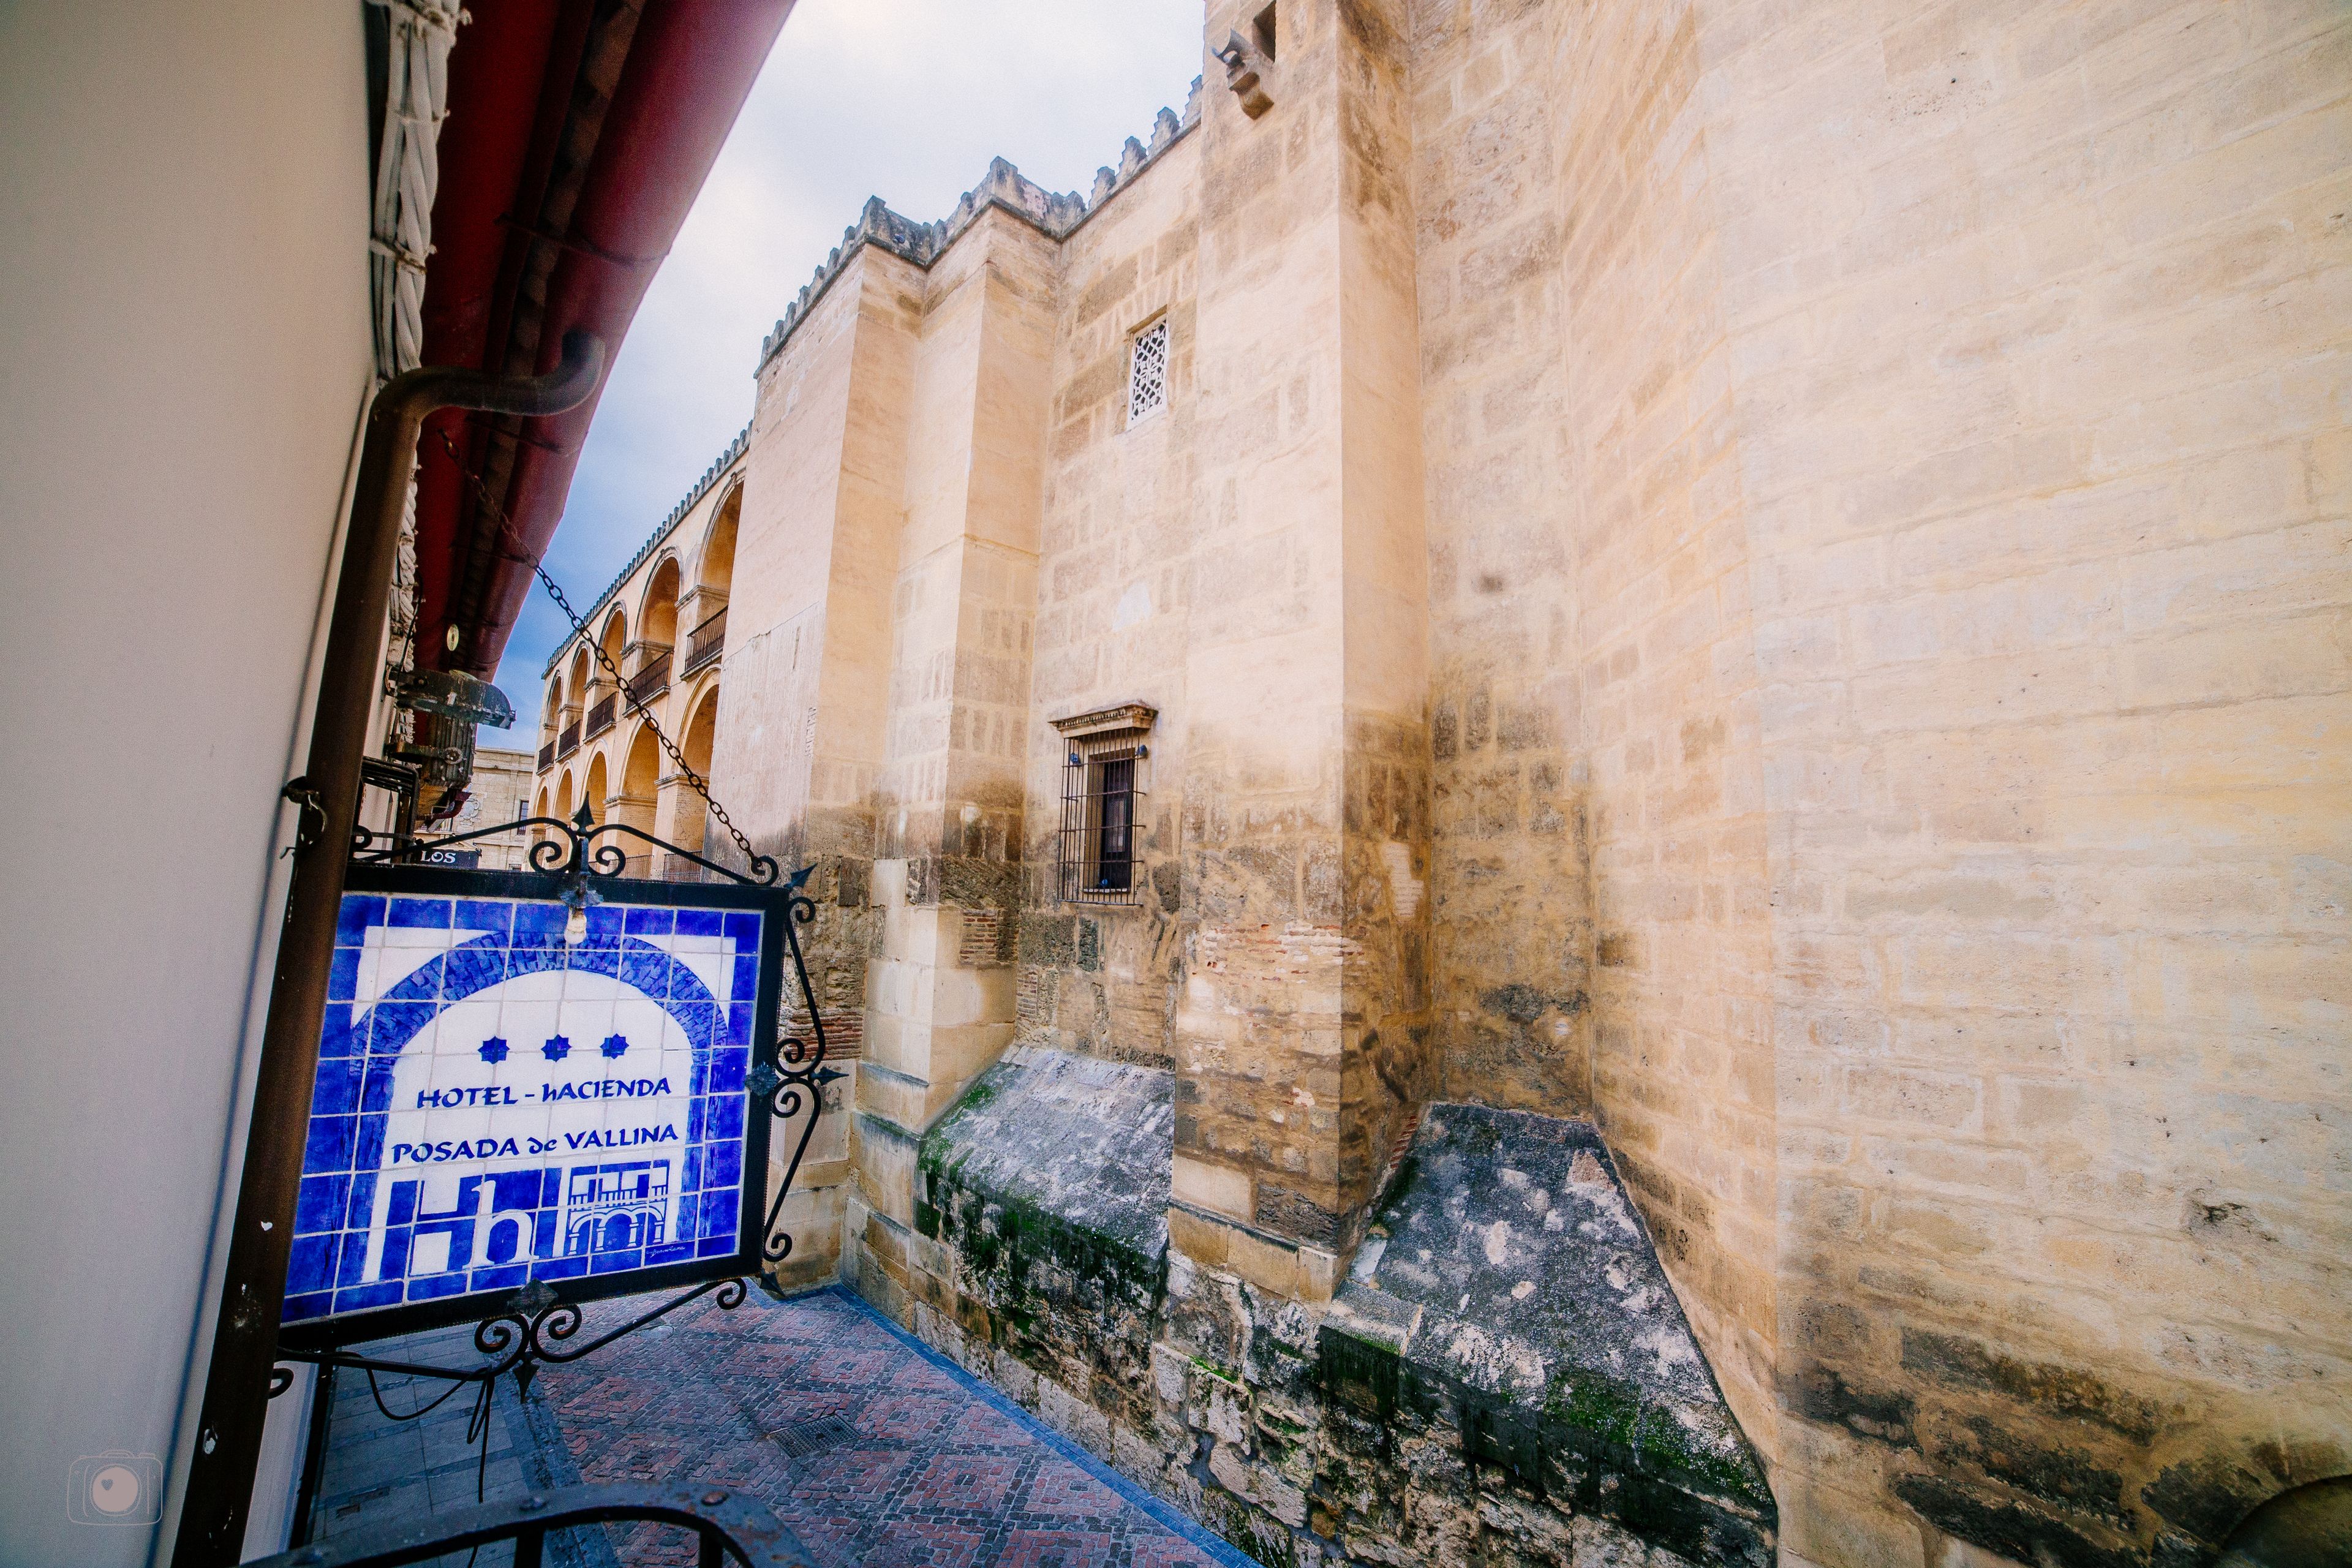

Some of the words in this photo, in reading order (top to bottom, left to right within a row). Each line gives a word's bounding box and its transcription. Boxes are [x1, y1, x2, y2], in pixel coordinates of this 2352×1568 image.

[420, 850, 456, 864] LOS
[416, 1086, 519, 1109] HOTEL
[391, 1137, 520, 1164] POSADA
[526, 1136, 557, 1155] de
[564, 1123, 679, 1150] VALLINA
